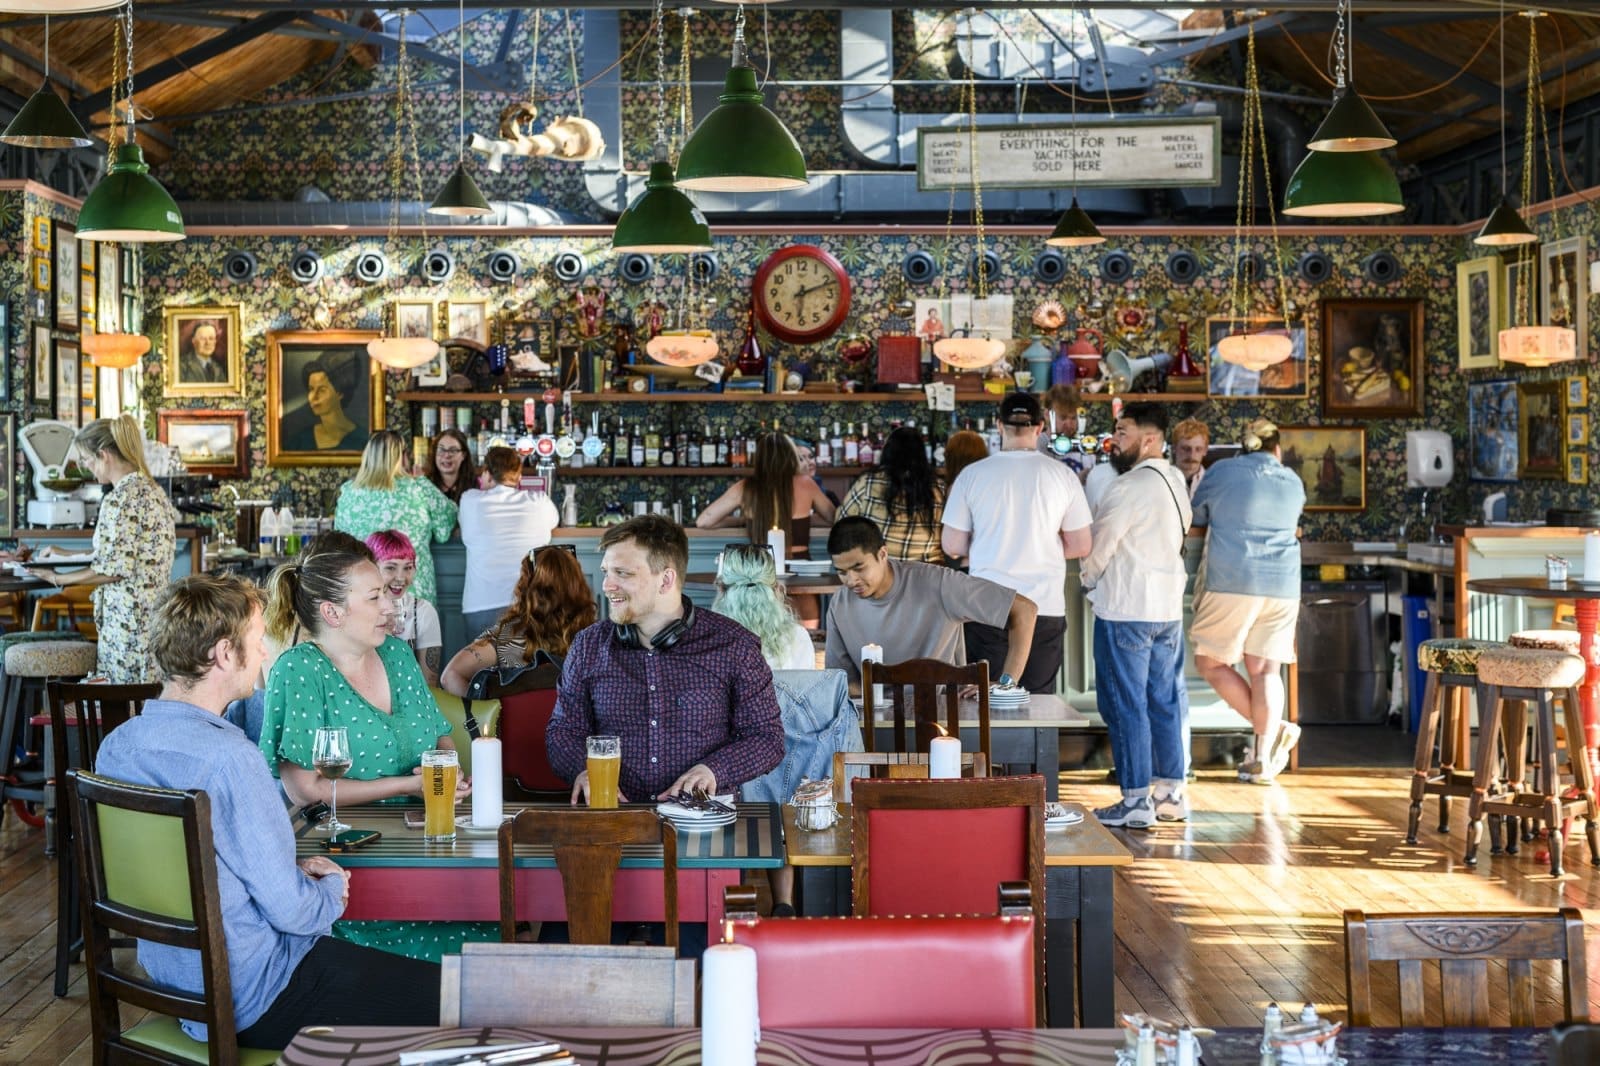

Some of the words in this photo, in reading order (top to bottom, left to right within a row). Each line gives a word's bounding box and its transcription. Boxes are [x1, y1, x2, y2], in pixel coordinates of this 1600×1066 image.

[999, 138, 1070, 150] EVERYTHING
[1081, 137, 1105, 148] FOR
[1116, 136, 1138, 147] THE
[1034, 149, 1101, 160] YACHTSMAN
[1032, 161, 1063, 172] SOLD
[1073, 160, 1102, 171] HERE
[785, 264, 793, 275] 11
[796, 260, 808, 271] 12
[773, 274, 784, 285] 10
[822, 274, 830, 285] 2
[770, 288, 778, 298] 9
[827, 288, 833, 299] 3
[774, 302, 782, 313] 8
[823, 304, 830, 312] 4
[784, 311, 792, 322] 7
[798, 315, 806, 326] 6
[812, 312, 820, 322] 5
[433, 765, 444, 795] BREWDOG
